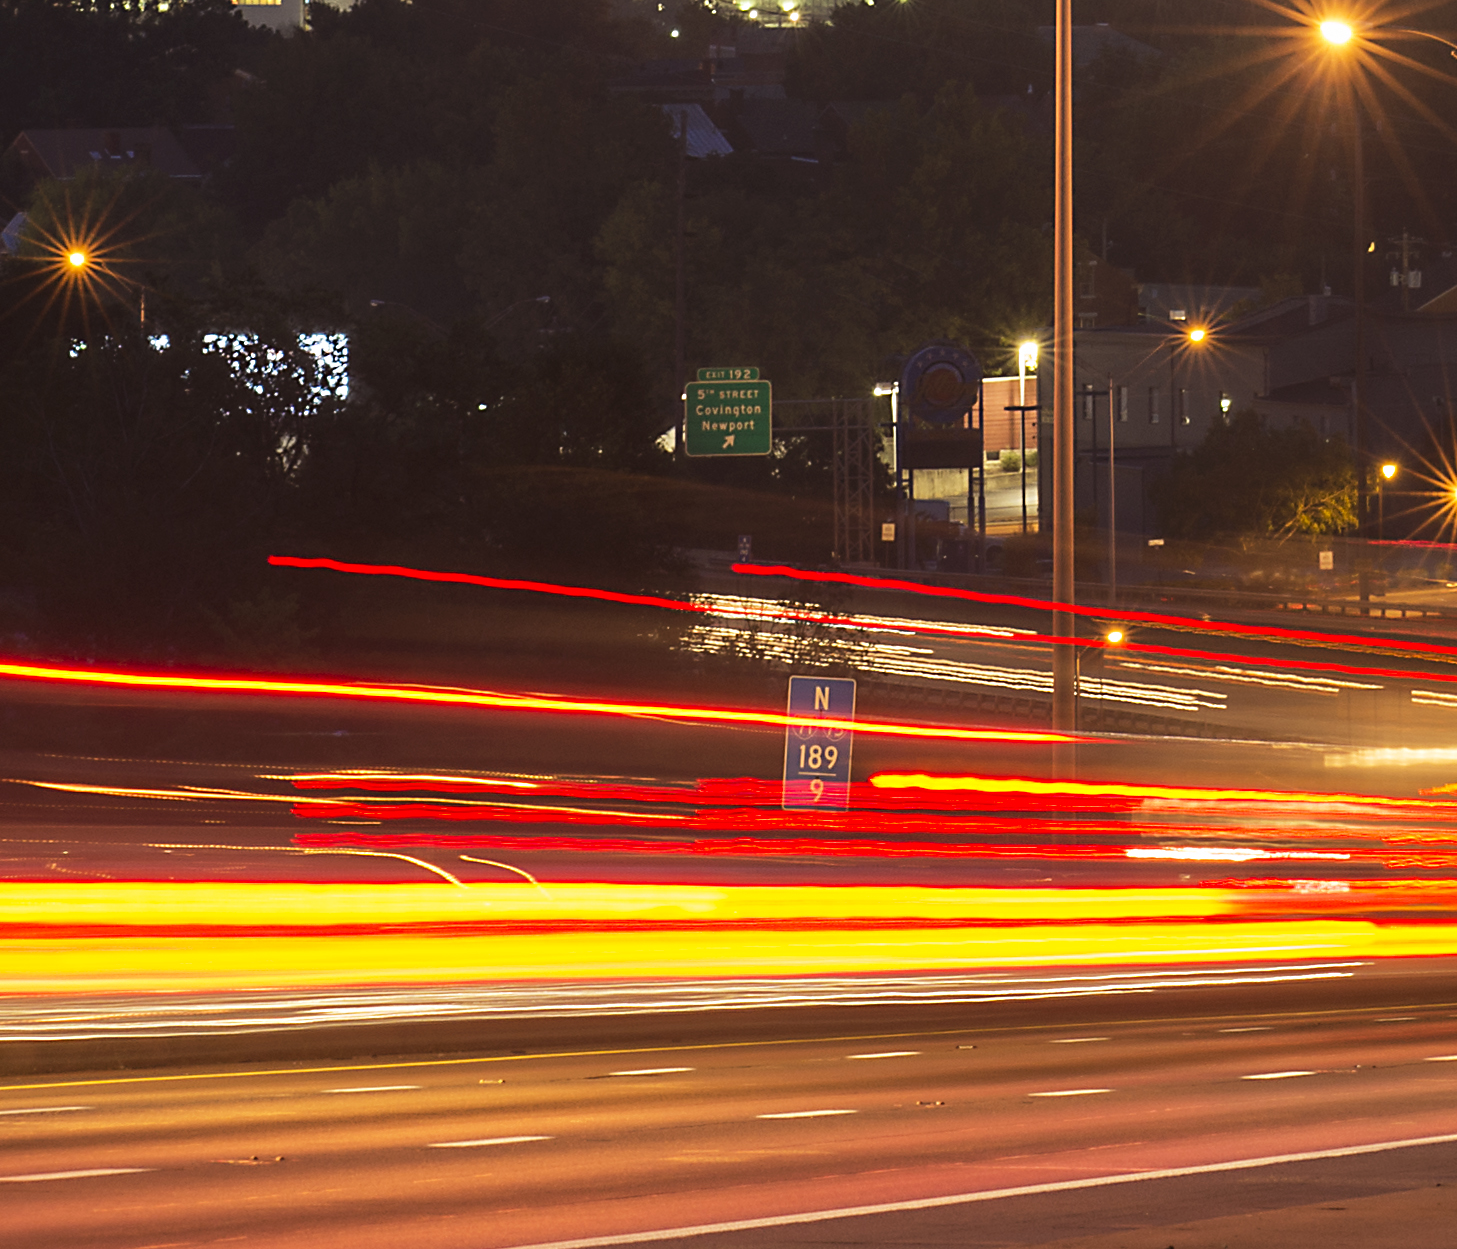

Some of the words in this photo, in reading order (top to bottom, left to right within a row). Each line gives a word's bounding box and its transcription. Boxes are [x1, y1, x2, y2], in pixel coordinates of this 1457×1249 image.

[706, 371, 725, 379] EXIT
[729, 369, 751, 379] 192
[719, 389, 759, 399] STREET
[696, 404, 761, 418] Covington
[702, 420, 754, 432] Newport
[814, 686, 830, 710] N
[799, 744, 838, 769] 189
[810, 778, 824, 802] 9
